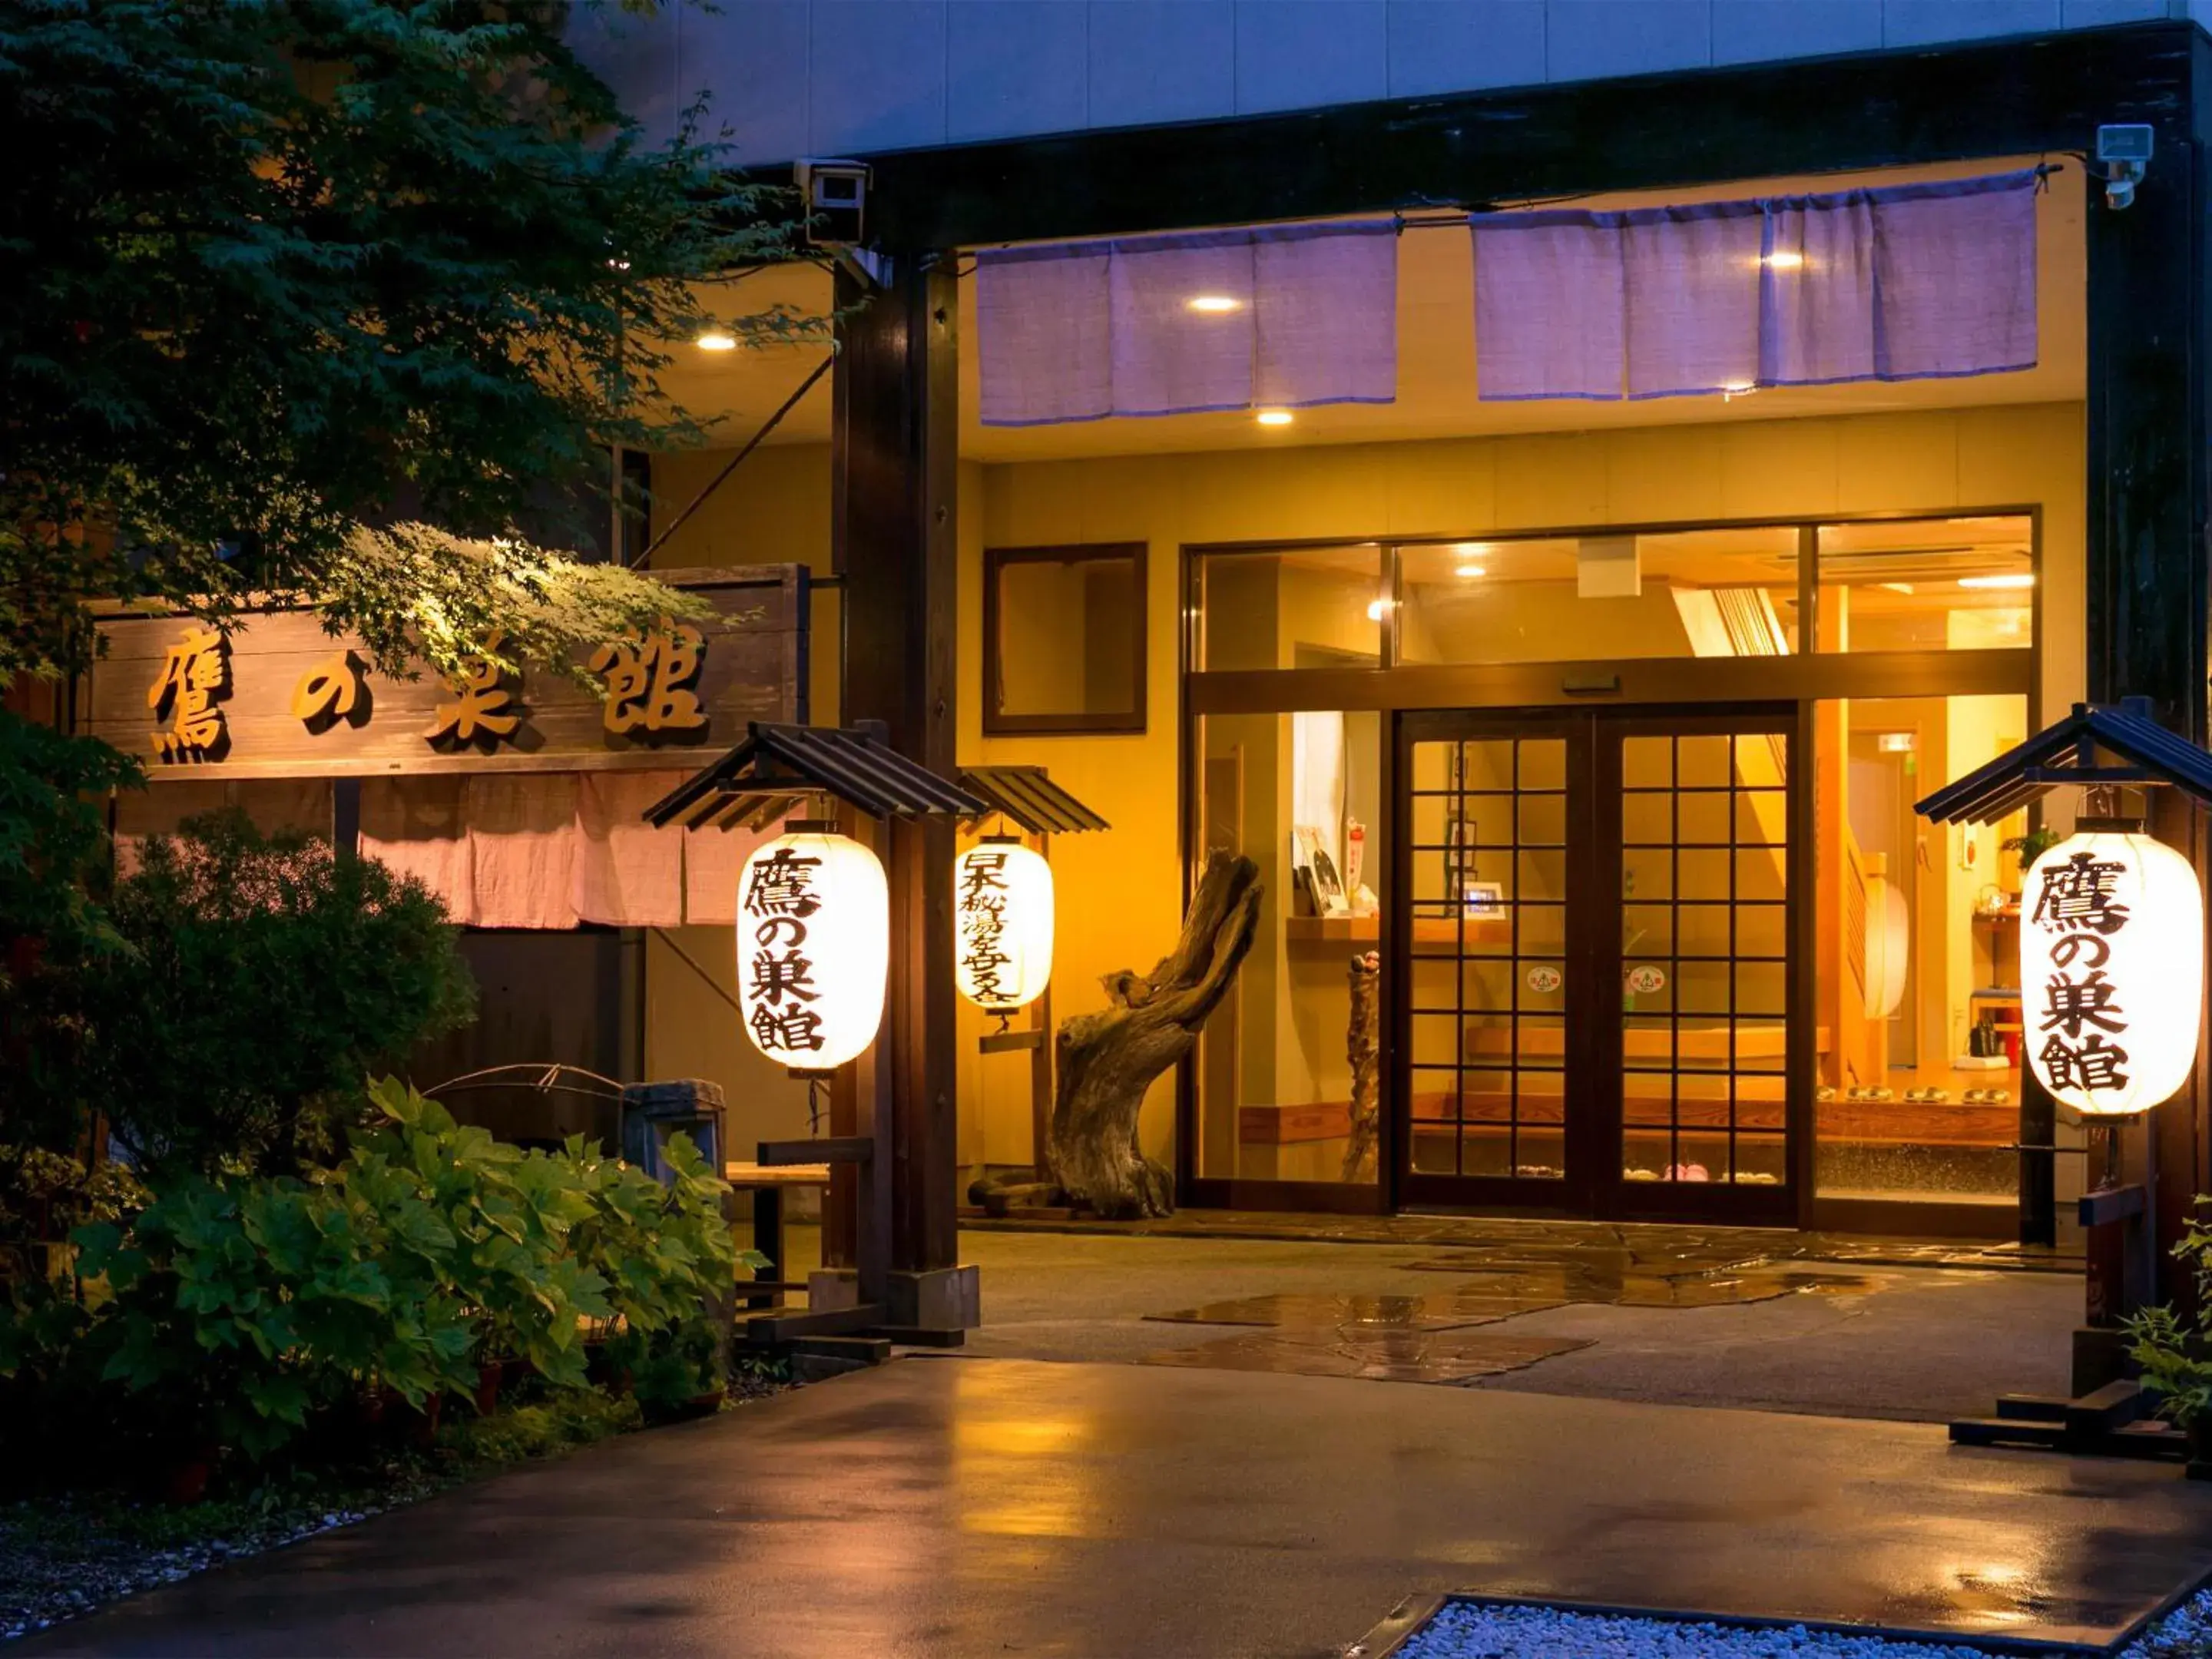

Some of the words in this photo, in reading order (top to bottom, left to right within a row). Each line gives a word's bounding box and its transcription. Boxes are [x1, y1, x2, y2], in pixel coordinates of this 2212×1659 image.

[743, 847, 826, 1051] 鷹の巣館
[2032, 851, 2131, 1091] 鷹の巣館
